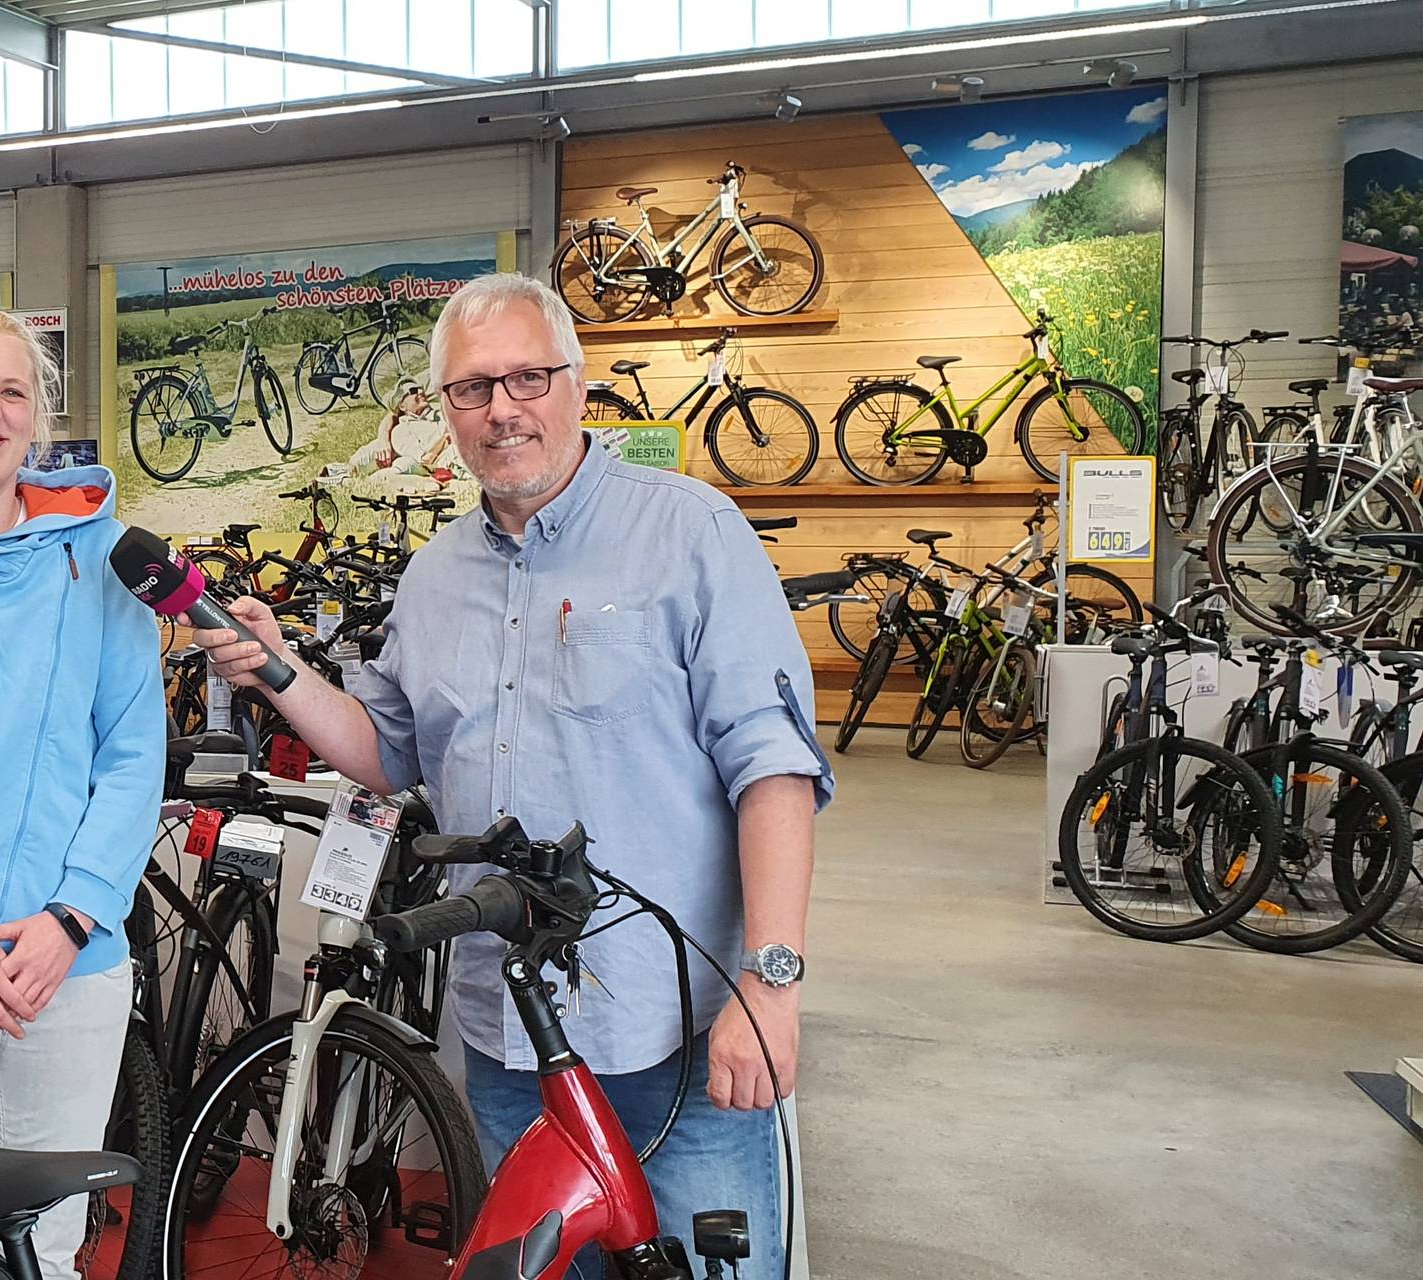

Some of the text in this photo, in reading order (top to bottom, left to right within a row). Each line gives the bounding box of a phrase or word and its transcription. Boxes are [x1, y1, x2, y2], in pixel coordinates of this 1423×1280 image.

[169, 261, 345, 292] ...mühelos zu den
[277, 277, 466, 308] schönsten Plätze
[25, 315, 61, 326] BOSCH
[632, 437, 671, 447] UNSERE
[627, 447, 675, 459] BESTEN
[1083, 469, 1143, 477] BULLS
[130, 575, 159, 596] RADIO
[280, 761, 297, 777] 25
[191, 834, 207, 852] 19
